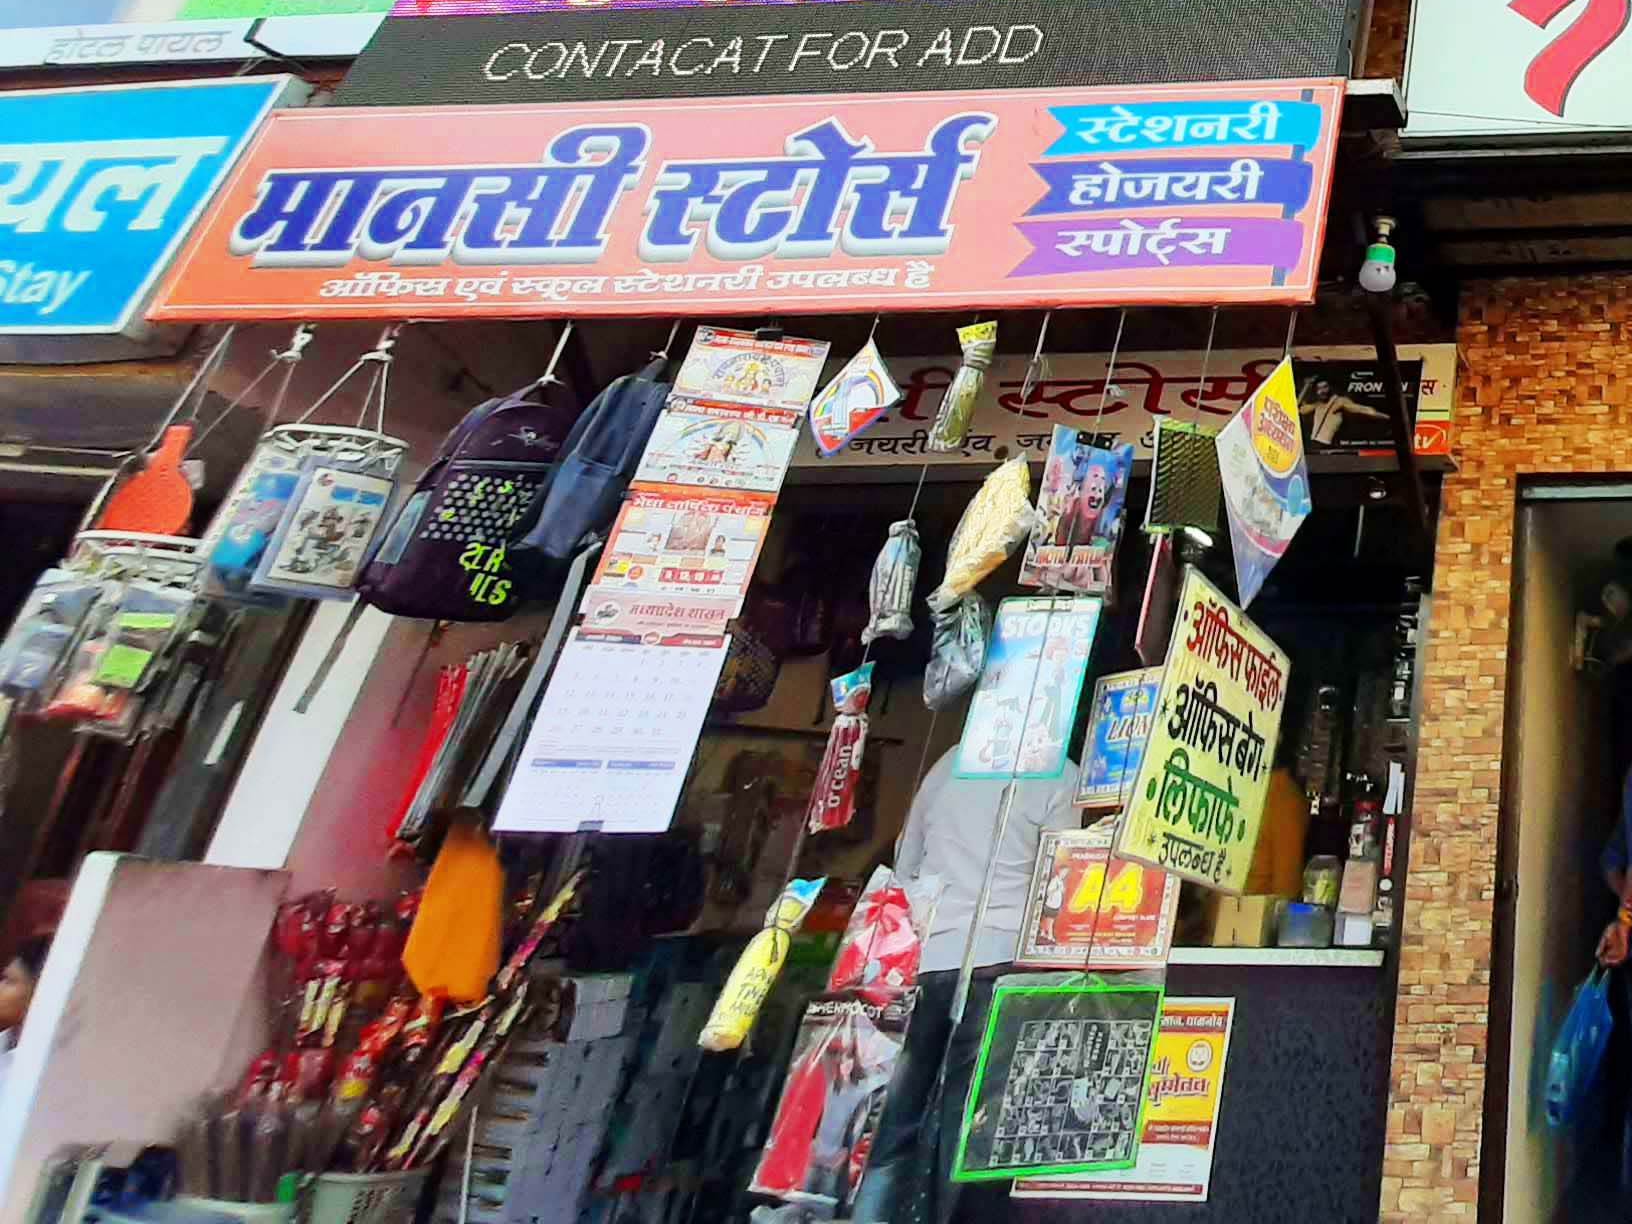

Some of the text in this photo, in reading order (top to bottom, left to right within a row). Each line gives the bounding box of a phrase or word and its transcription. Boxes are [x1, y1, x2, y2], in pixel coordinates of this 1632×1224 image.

[480, 23, 1045, 82] CONTACAT FOR ADD
[1077, 103, 1284, 145] स्टेशनरी
[229, 111, 999, 267] मानसी स्टोर्स
[1067, 158, 1264, 207] होजयरी
[319, 259, 936, 303] ऑफिस एवं स्कूल स्टेशनरी उपलब्ध है
[1167, 674, 1240, 768] ऑफिस
